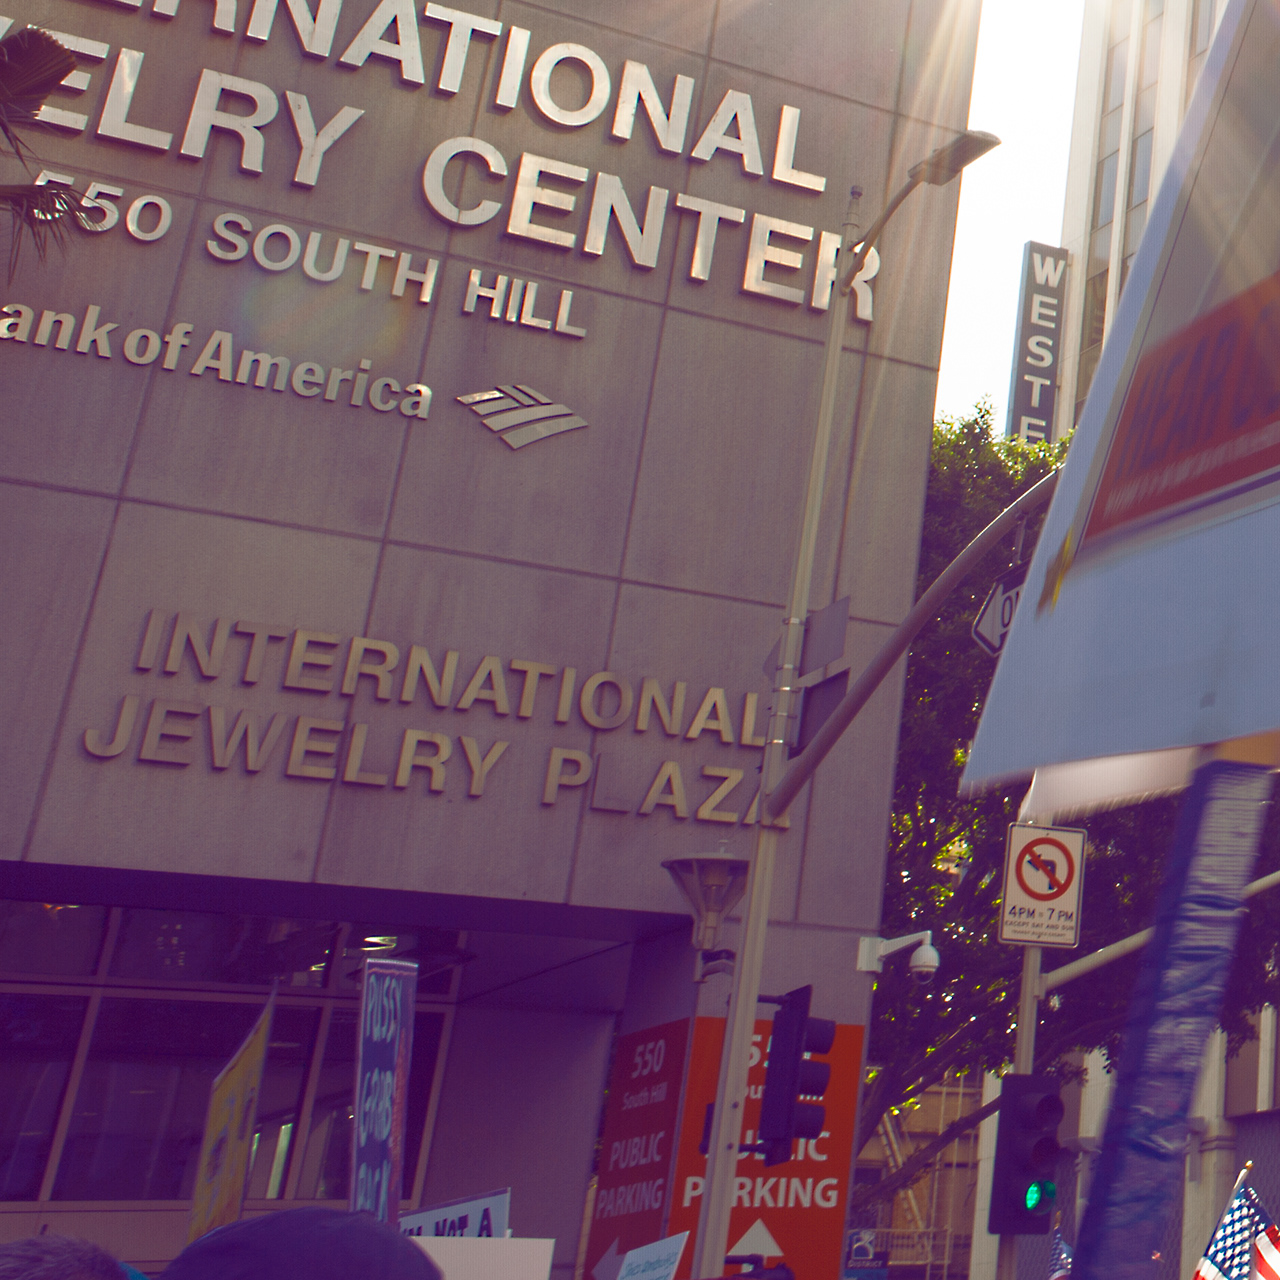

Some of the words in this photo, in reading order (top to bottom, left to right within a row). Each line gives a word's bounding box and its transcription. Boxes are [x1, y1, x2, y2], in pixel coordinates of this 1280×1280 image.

[422, 134, 882, 323] CENTER
[205, 209, 441, 306] SOUTH
[462, 267, 588, 339] HILL
[123, 322, 195, 371] of
[190, 329, 434, 421] America
[135, 607, 766, 750] INTERNATIONAL
[83, 694, 509, 802] JEWELRY
[631, 1038, 666, 1079] 550
[622, 1086, 650, 1112] South
[651, 1081, 668, 1104] Hill
[608, 1131, 665, 1172] PUBLIC
[596, 1177, 665, 1220] PARKING
[682, 1176, 839, 1208] PRKING
